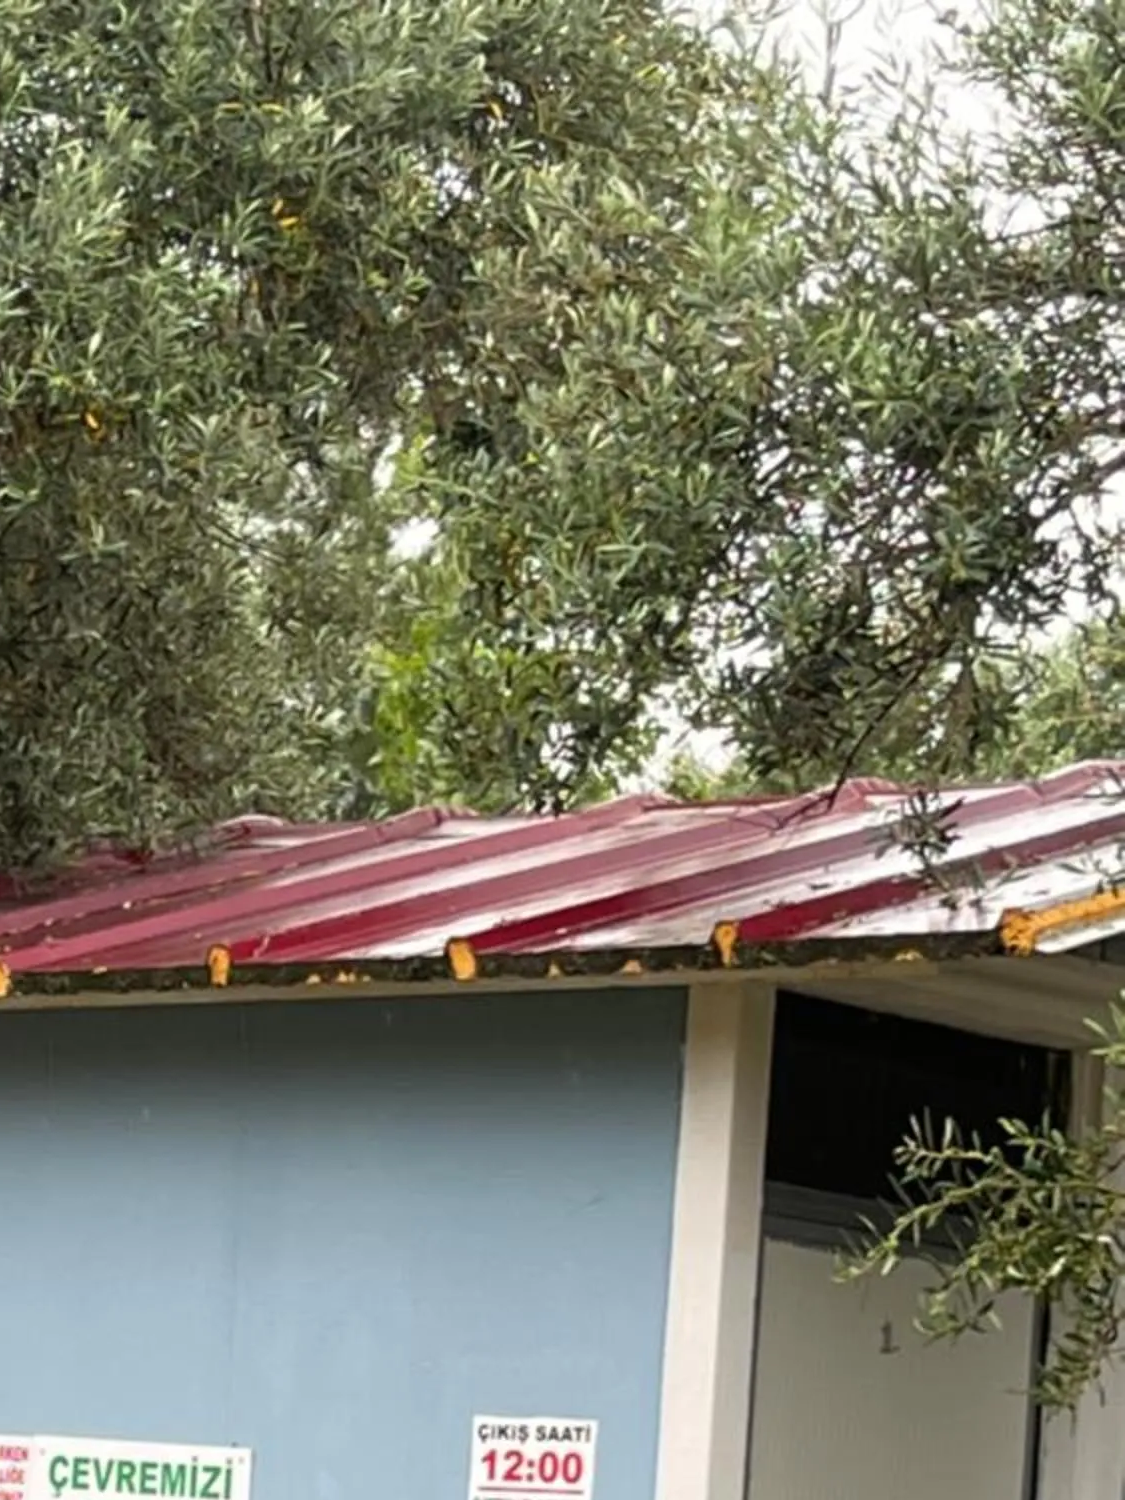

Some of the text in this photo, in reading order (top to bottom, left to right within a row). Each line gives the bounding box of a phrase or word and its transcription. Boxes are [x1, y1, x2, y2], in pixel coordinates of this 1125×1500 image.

[478, 1424, 592, 1445] ÇIKIŞ SAATİ
[49, 1454, 233, 1500] ÇEVREMİZİ
[481, 1448, 583, 1485] 12:00
